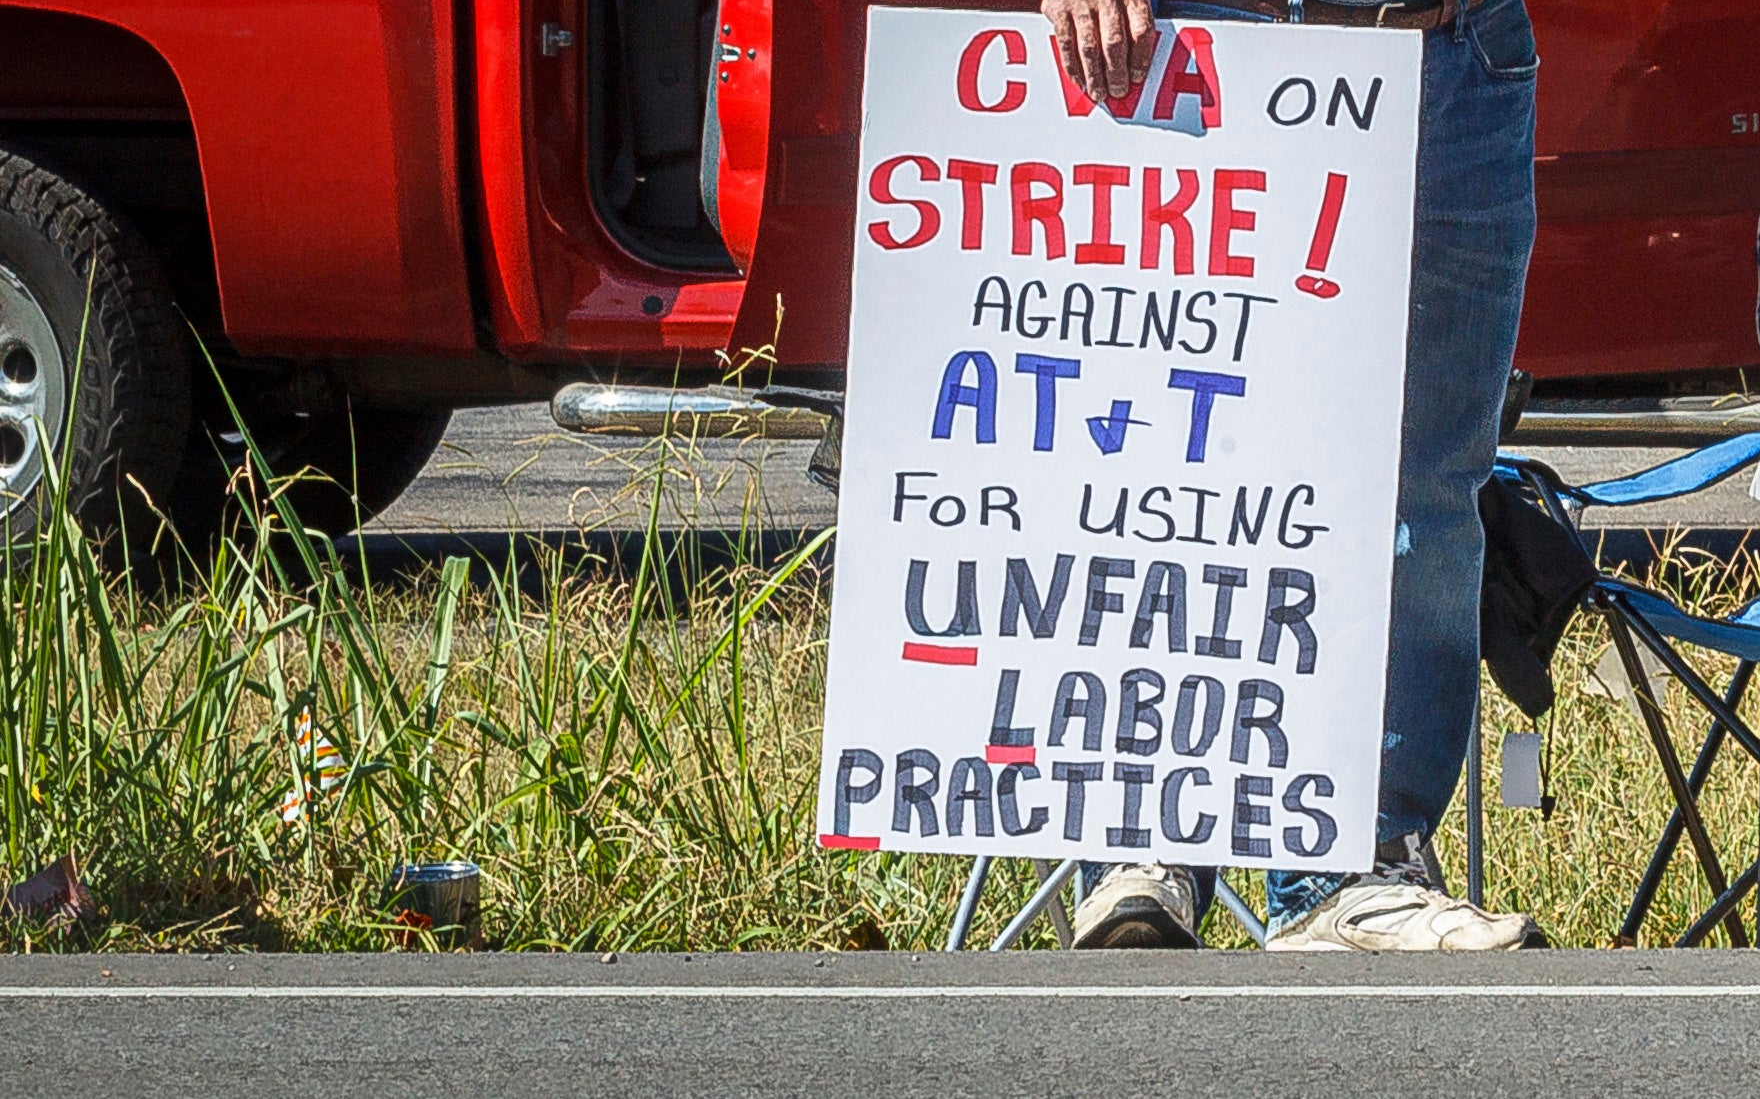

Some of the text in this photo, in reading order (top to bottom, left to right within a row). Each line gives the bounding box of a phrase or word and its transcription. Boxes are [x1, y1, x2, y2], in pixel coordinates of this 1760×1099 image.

[1266, 75, 1383, 131] ON
[972, 275, 1279, 362] AGAINST
[1078, 483, 1330, 549] USING
[904, 553, 1319, 675] UNFAIR
[988, 667, 1290, 769] LABOR
[833, 747, 1338, 858] PRACTICES
